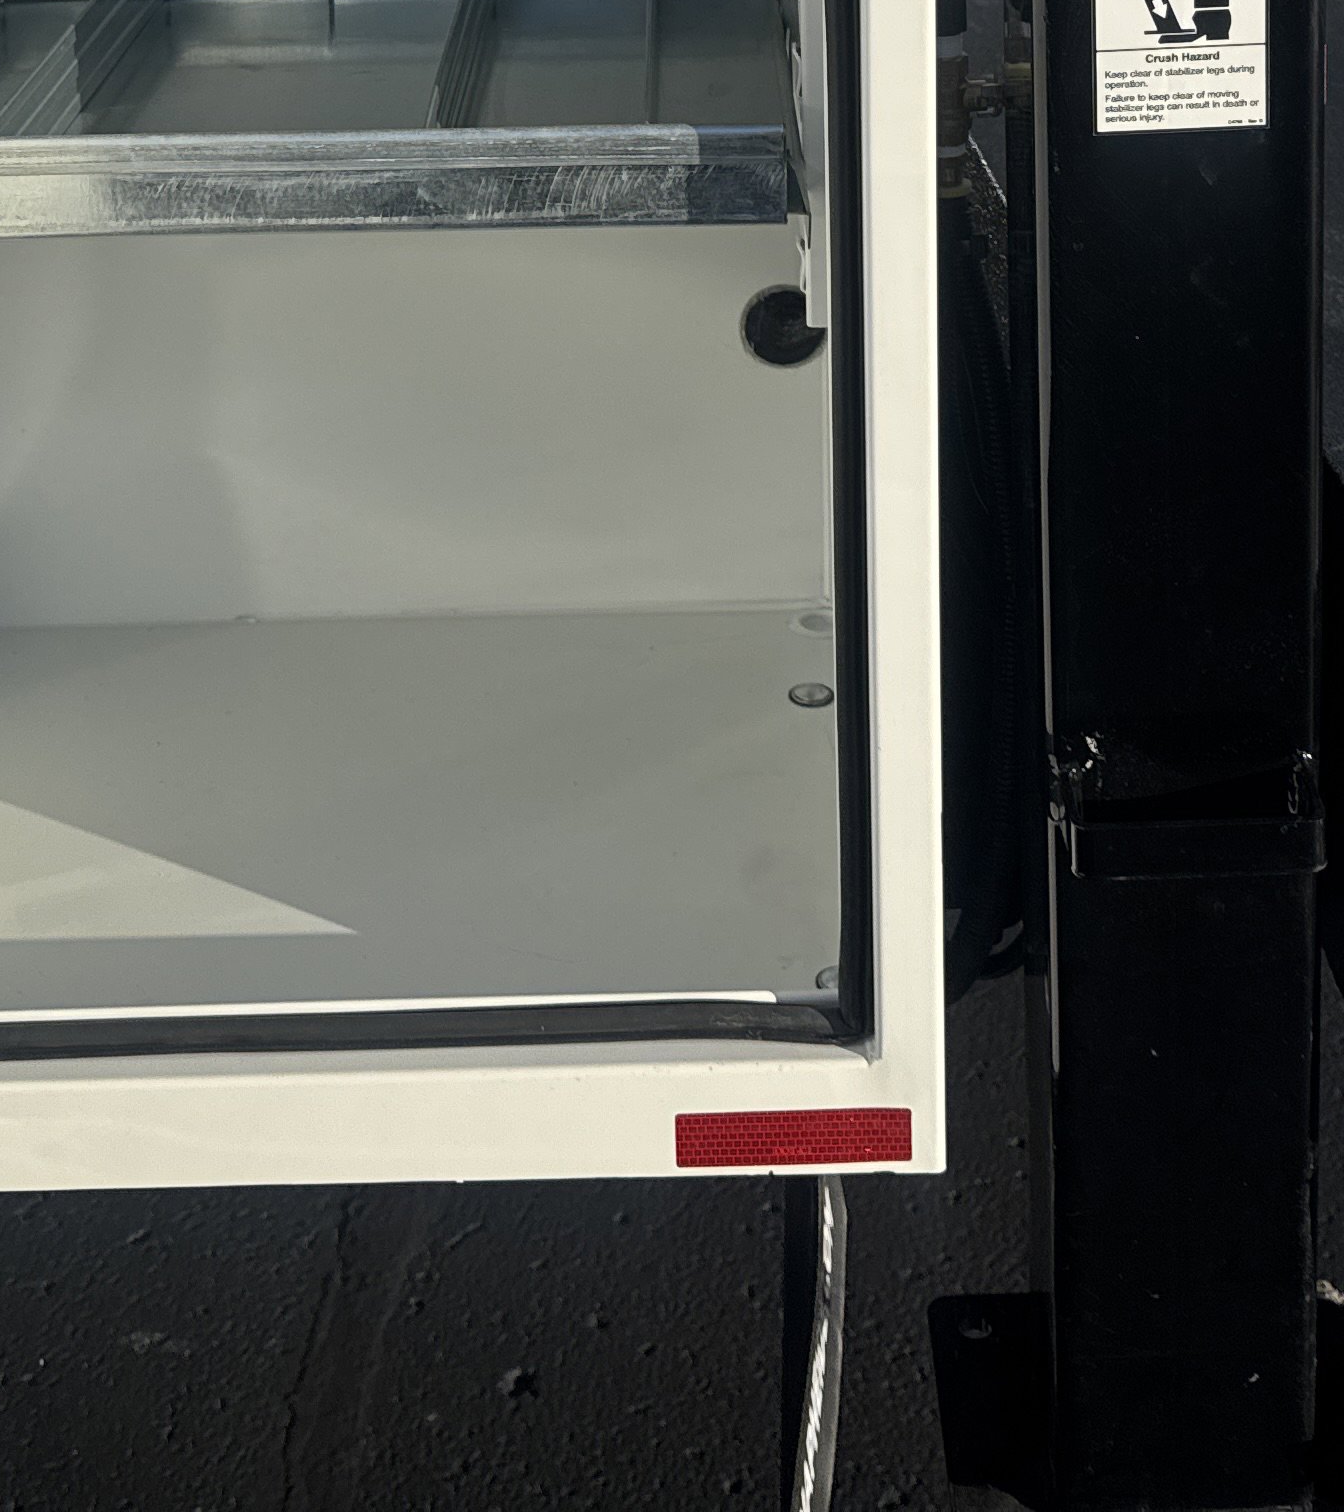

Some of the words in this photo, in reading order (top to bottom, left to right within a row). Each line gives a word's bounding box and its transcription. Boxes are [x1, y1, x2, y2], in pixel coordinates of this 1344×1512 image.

[1145, 53, 1179, 64] Crush
[1181, 51, 1220, 62] Hazard
[1105, 69, 1128, 79] Keep
[1130, 68, 1152, 77] clear
[1154, 68, 1164, 77] of
[1165, 66, 1204, 76] stabilizer
[1206, 66, 1225, 75] legs
[1227, 65, 1255, 75] during
[1105, 80, 1149, 90] operation.
[1105, 94, 1136, 103] Failure
[1137, 94, 1146, 102] to
[1148, 93, 1170, 103] keep
[1172, 92, 1195, 100] clear
[1196, 91, 1207, 99] of
[1207, 90, 1240, 100] moving
[1105, 104, 1144, 113] stabilizer
[1146, 104, 1165, 113] legs
[1167, 103, 1184, 111] can
[1186, 101, 1210, 109] result
[1212, 100, 1221, 109] in
[1222, 99, 1248, 108] death
[1250, 99, 1260, 107] or
[1105, 114, 1137, 123] serious
[1139, 113, 1164, 122] injury.
